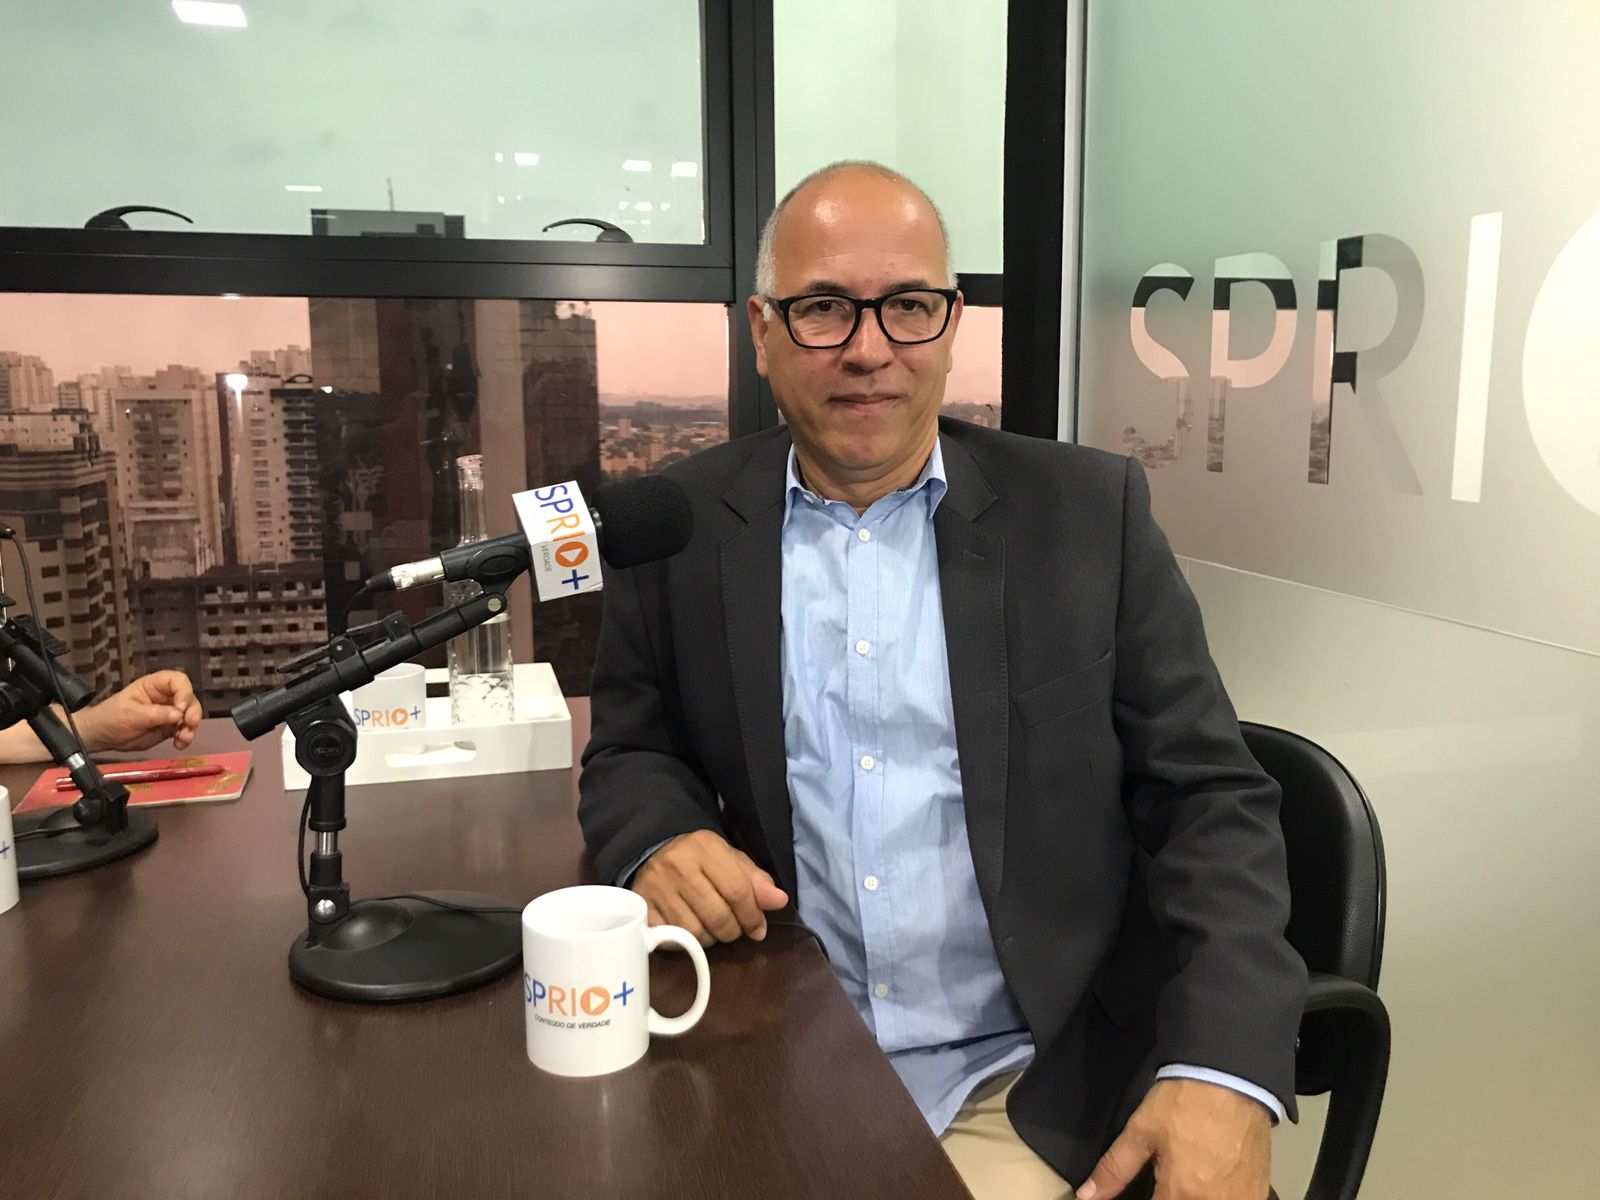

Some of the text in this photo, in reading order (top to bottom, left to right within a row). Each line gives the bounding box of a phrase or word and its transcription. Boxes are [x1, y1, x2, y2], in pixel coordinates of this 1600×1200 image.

[1123, 205, 1600, 520] SPRI
[566, 1021, 576, 1029] DE
[578, 1019, 611, 1029] VERDADE
